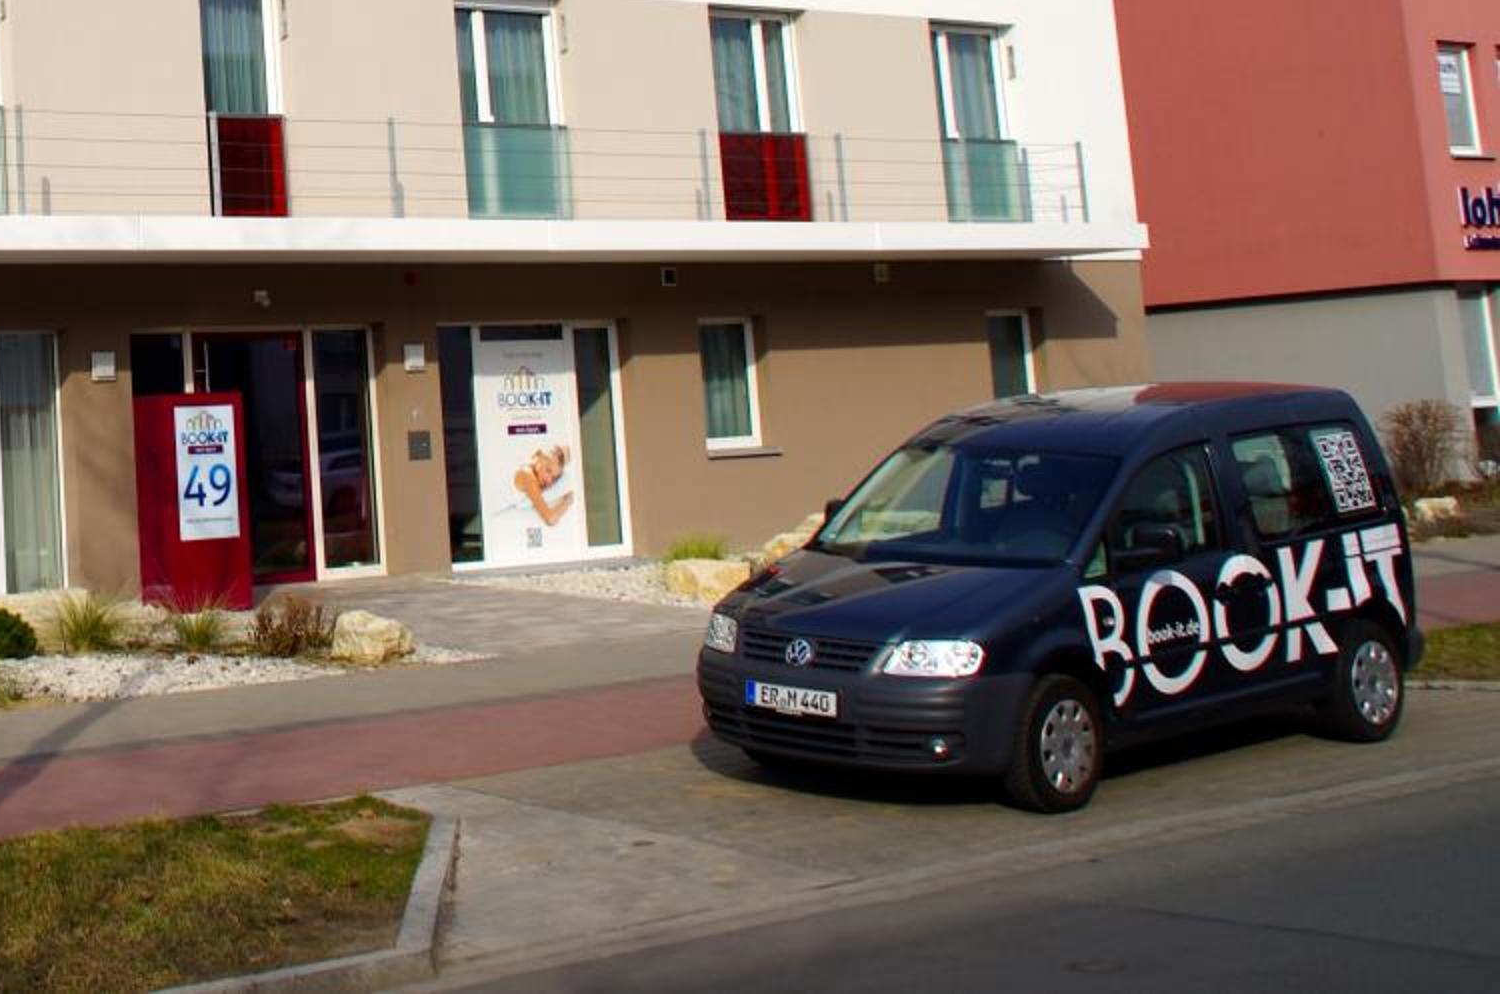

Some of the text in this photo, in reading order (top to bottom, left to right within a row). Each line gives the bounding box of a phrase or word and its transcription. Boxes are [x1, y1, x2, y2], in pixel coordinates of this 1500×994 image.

[498, 391, 552, 407] BOOK-IT
[181, 430, 229, 445] BOOK-IT
[184, 464, 231, 507] 49
[1077, 523, 1407, 708] BOOK-IT
[800, 692, 829, 712] 440
